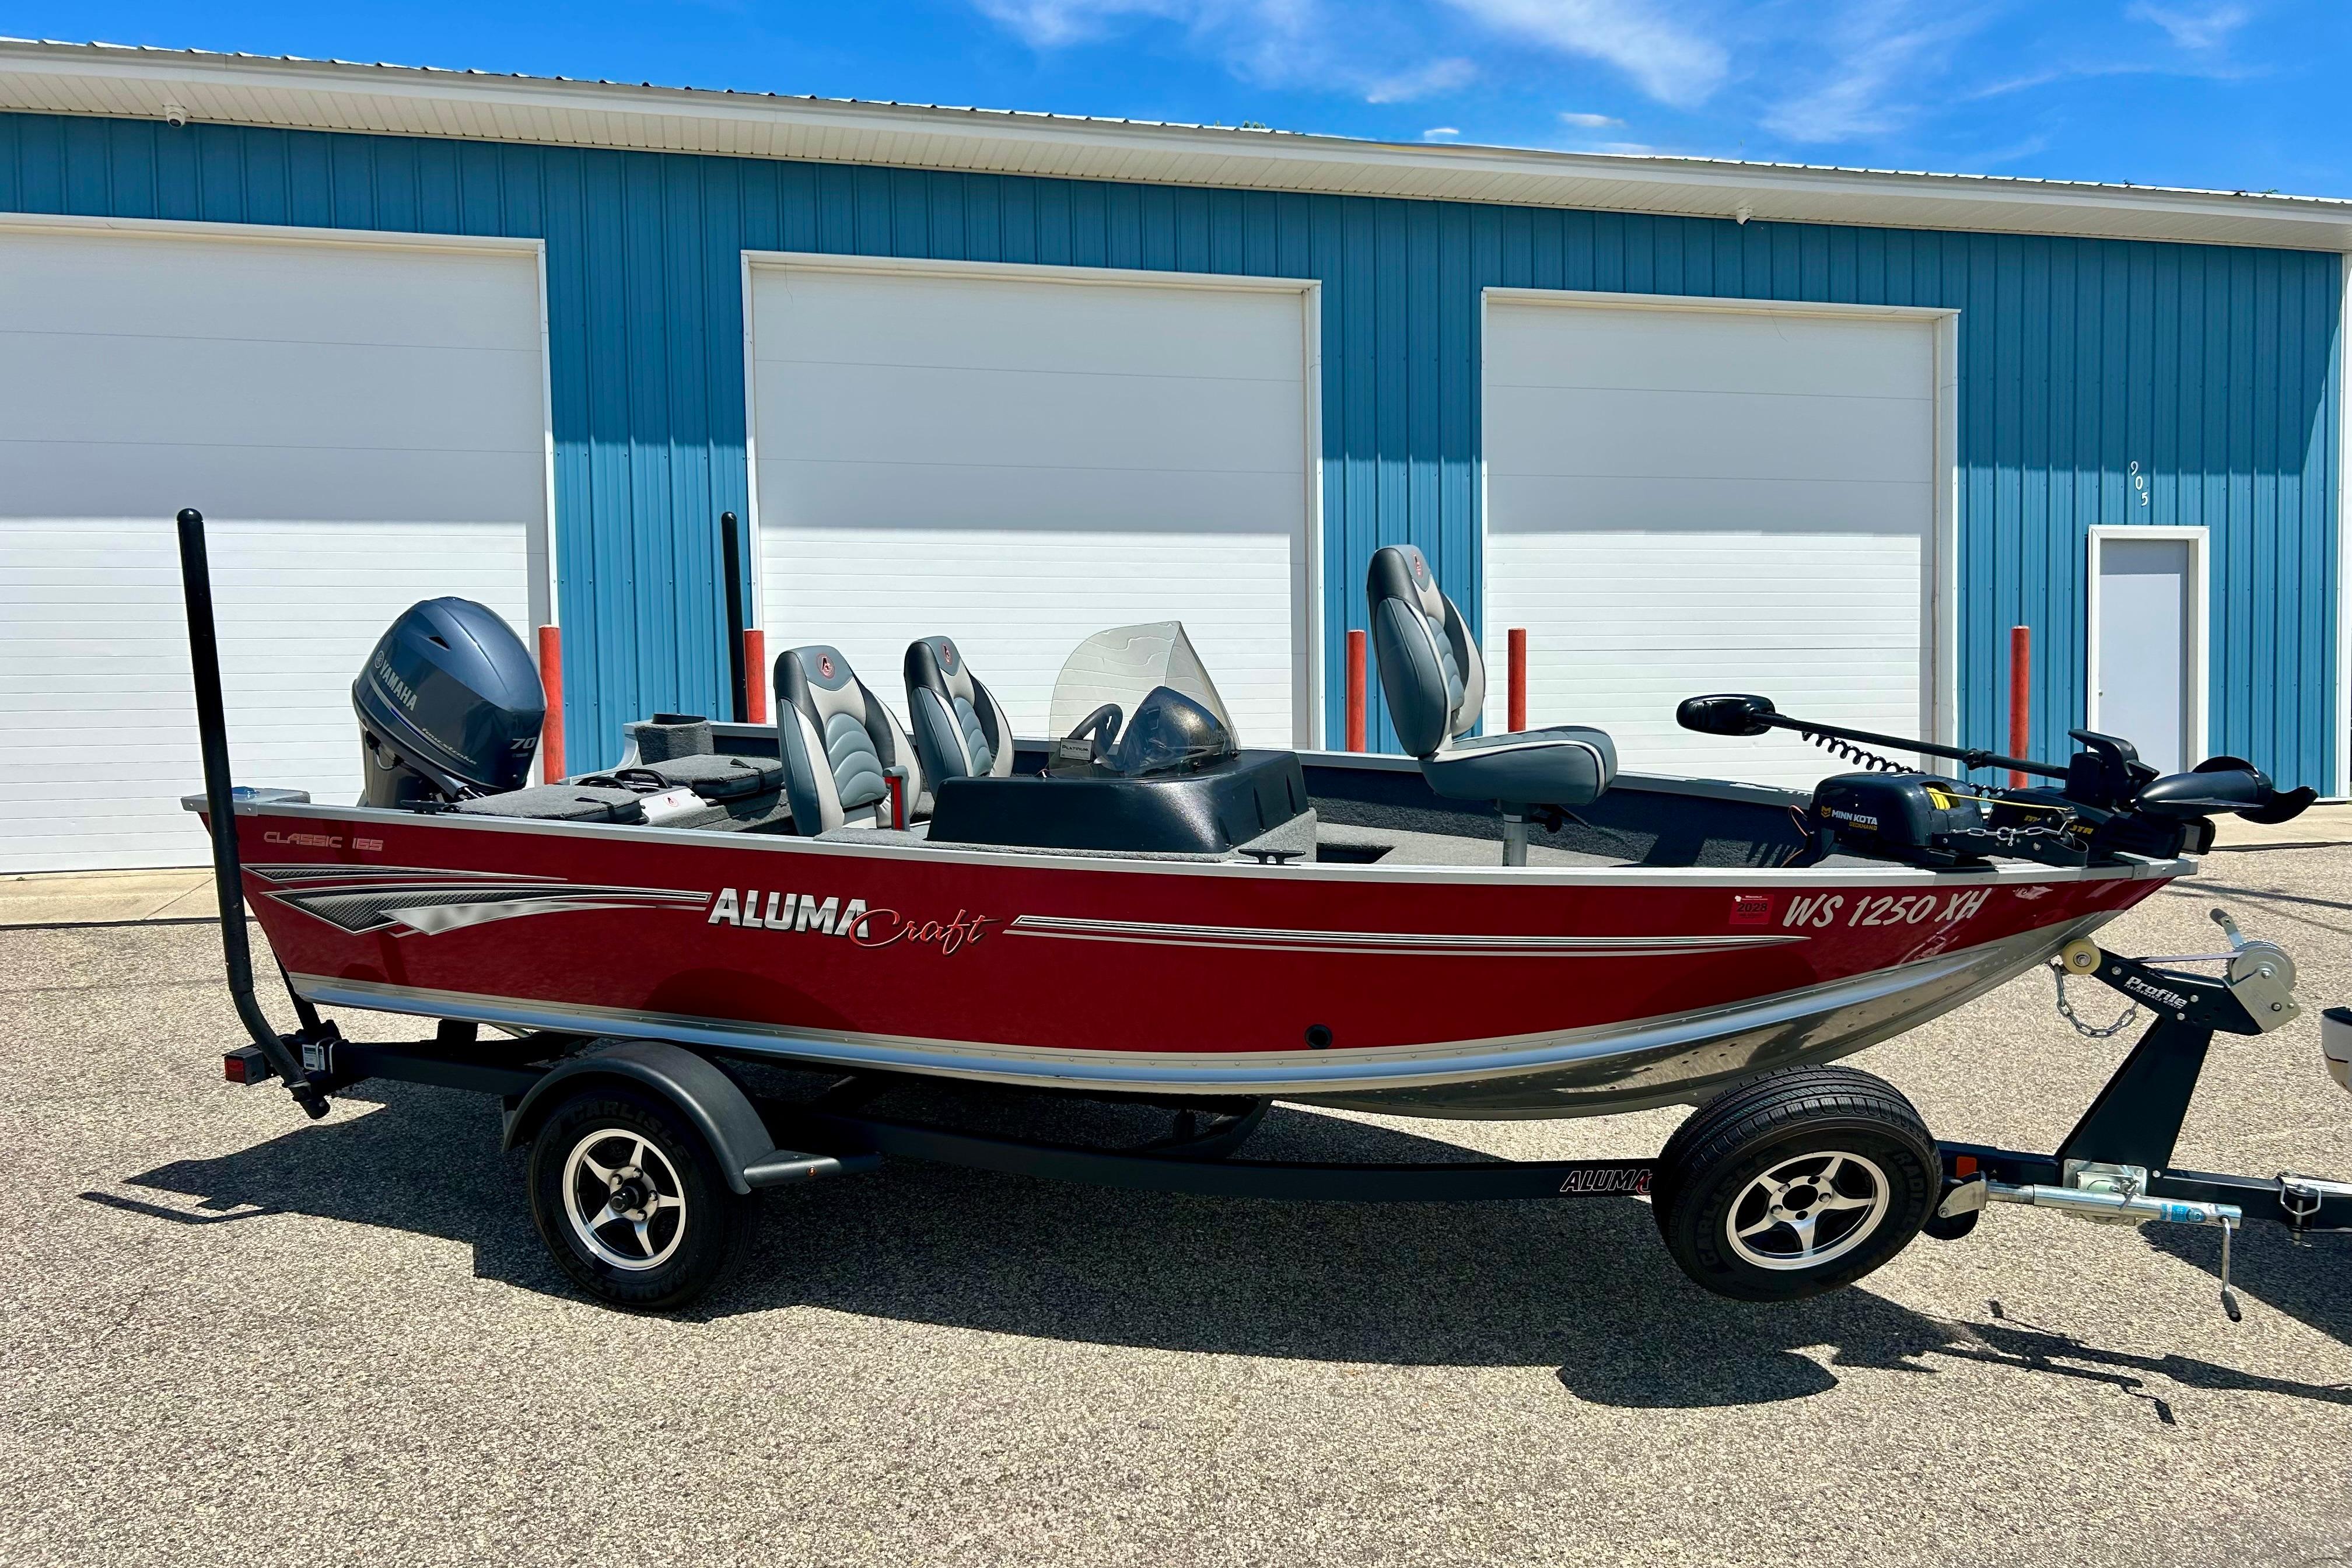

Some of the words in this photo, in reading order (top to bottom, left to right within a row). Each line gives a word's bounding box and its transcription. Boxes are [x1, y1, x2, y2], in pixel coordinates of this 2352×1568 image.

[2130, 460, 2148, 506] 905
[380, 659, 418, 711] YAMAHA
[510, 737, 537, 750] 70
[1832, 810, 1853, 821] MINN
[1853, 814, 1878, 825] KOTA
[1849, 821, 1877, 831] DECKHAND
[264, 831, 342, 848] CLASSIC
[352, 837, 384, 851] 165
[1783, 893, 1844, 928] WS
[1848, 895, 1937, 926] 1250
[1934, 888, 1992, 923] XH
[2125, 976, 2188, 1007] Profile
